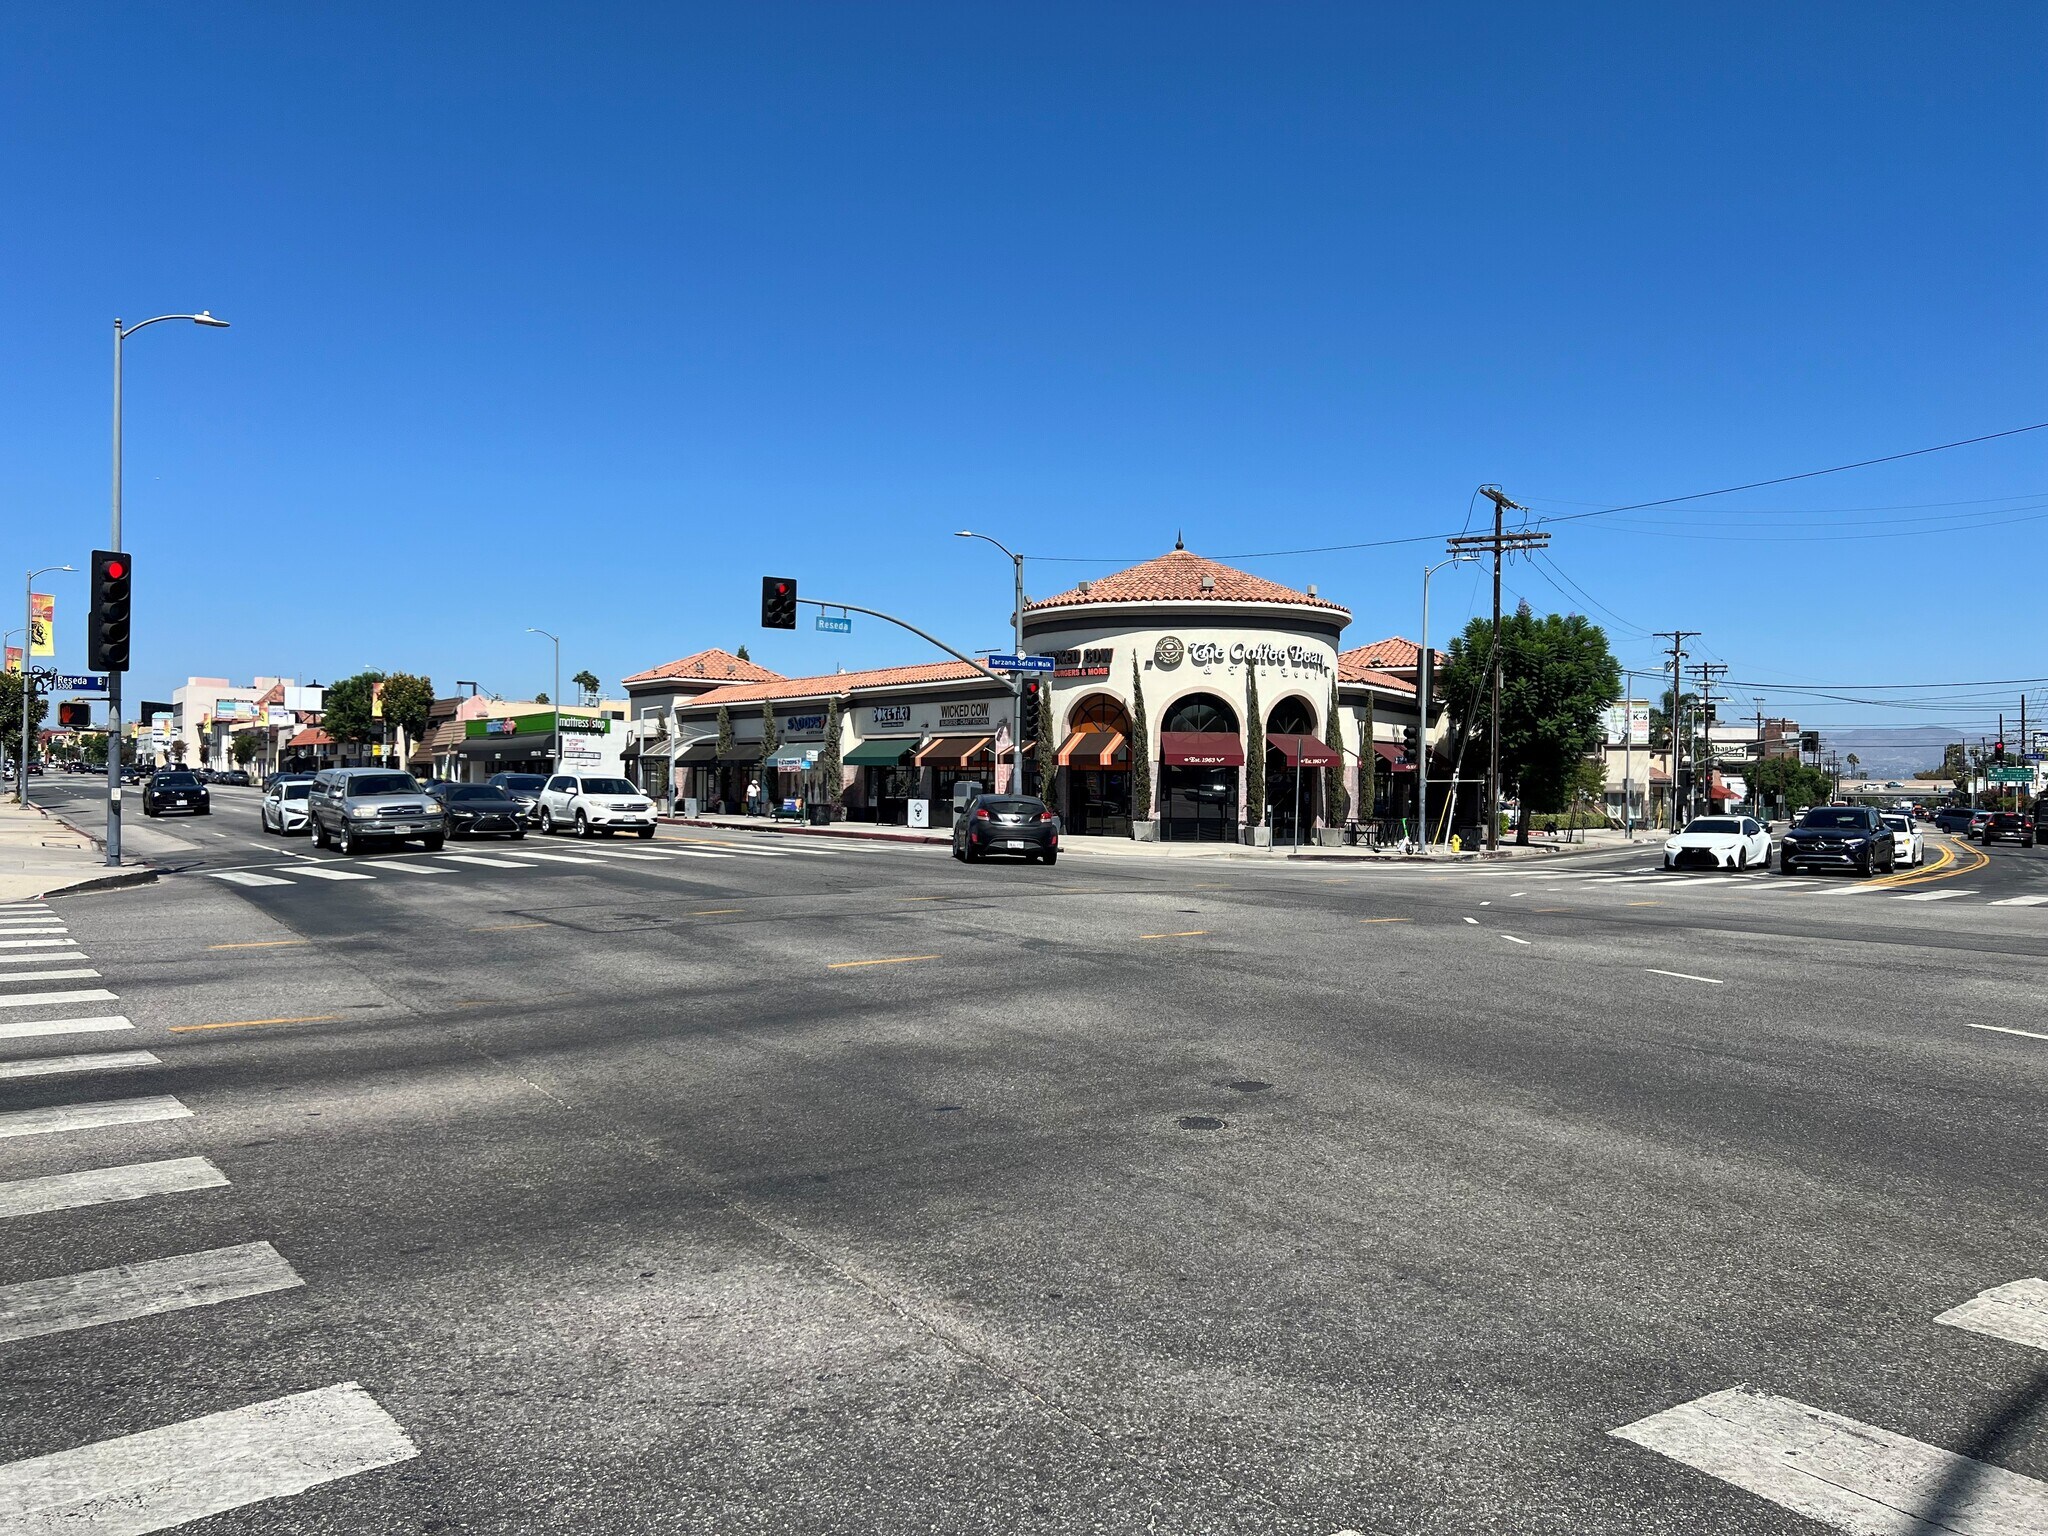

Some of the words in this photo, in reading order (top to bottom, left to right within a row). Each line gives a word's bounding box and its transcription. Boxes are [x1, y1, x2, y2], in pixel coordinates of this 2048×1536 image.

[818, 619, 849, 631] Reseda
[1083, 648, 1114, 664] COW
[1187, 642, 1224, 662] The
[1229, 642, 1286, 661] Coffee
[991, 658, 1016, 667] Tarzana
[1017, 659, 1036, 668] Safari
[1037, 661, 1052, 669] Walk
[1054, 669, 1080, 677] BURGERS
[1081, 668, 1087, 676] &
[1087, 667, 1108, 676] MORE
[57, 675, 88, 685] Reseda
[940, 704, 970, 718] WICKED
[970, 703, 989, 717] COW
[558, 717, 589, 728] mattress
[591, 719, 606, 731] stop
